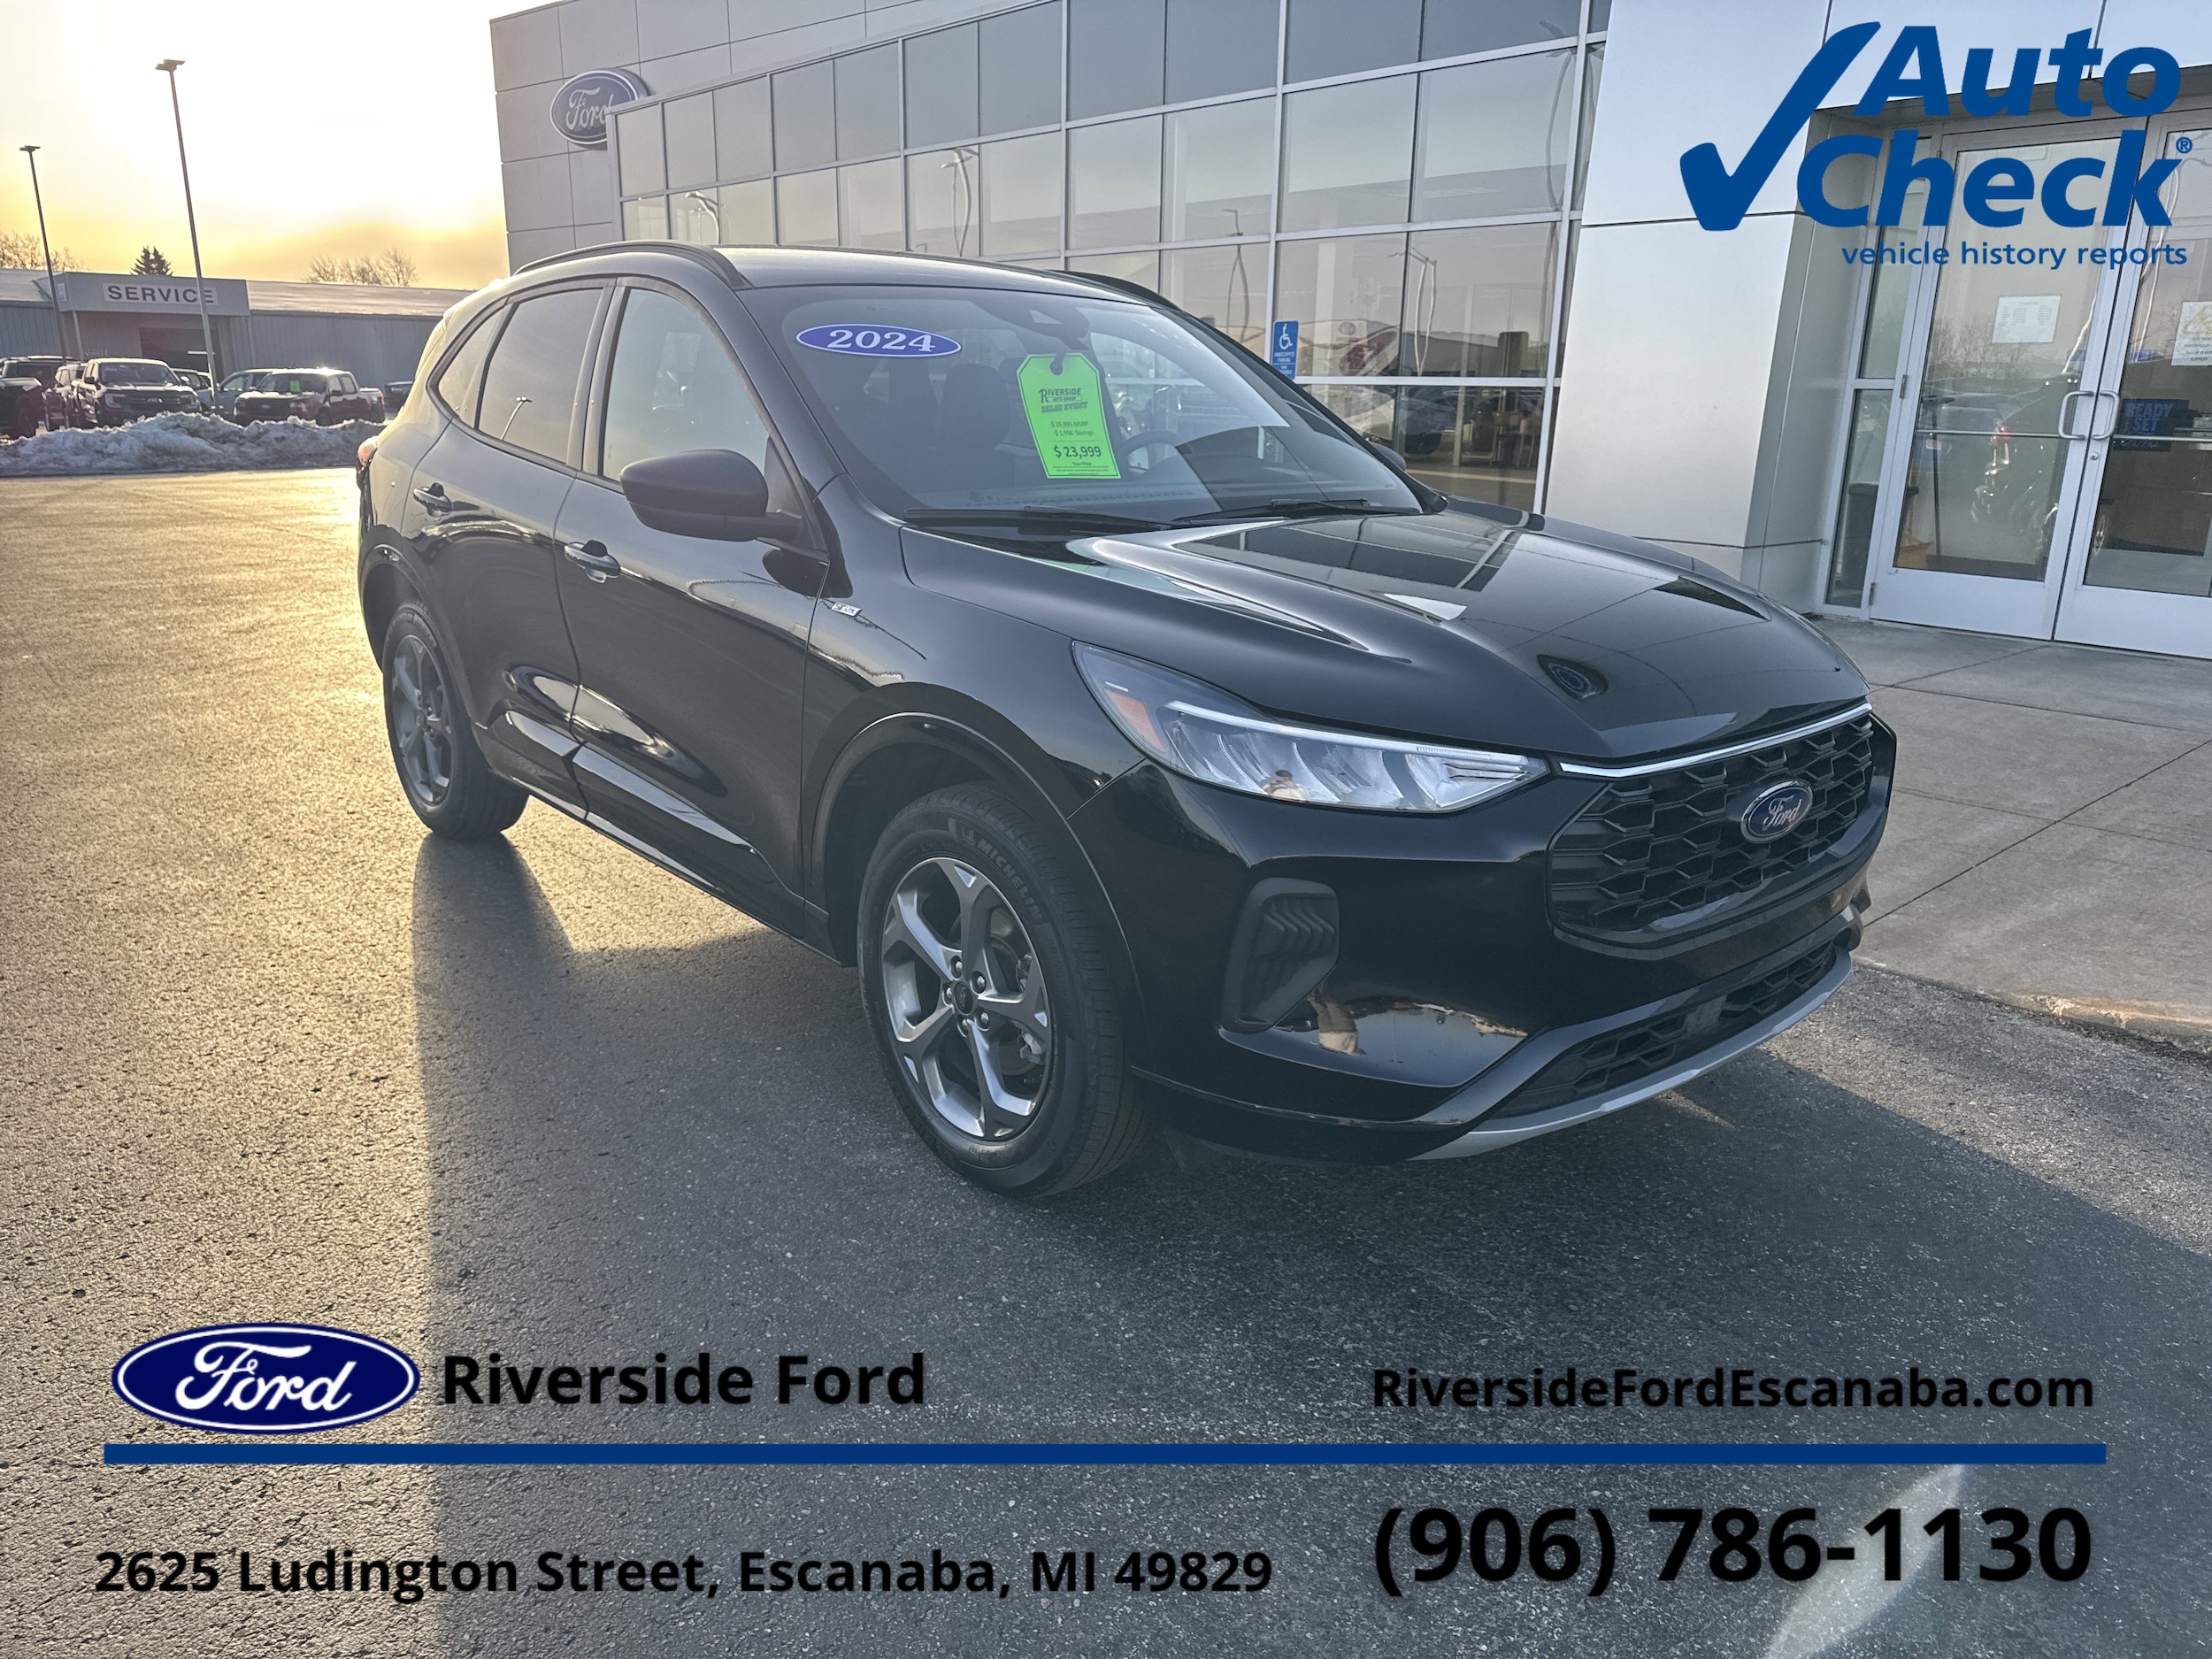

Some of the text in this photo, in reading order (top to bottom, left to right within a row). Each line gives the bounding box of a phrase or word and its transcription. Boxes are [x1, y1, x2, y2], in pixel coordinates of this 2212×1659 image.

[566, 87, 614, 131] Ford
[107, 285, 214, 303] SERVICE
[826, 329, 936, 352] 2024
[1039, 388, 1081, 403] RIVERSIDE
[2125, 403, 2174, 418] READY
[1054, 444, 1102, 459] $ 23,999
[1763, 795, 1802, 831] Ford
[977, 839, 1042, 920] MICHELIN
